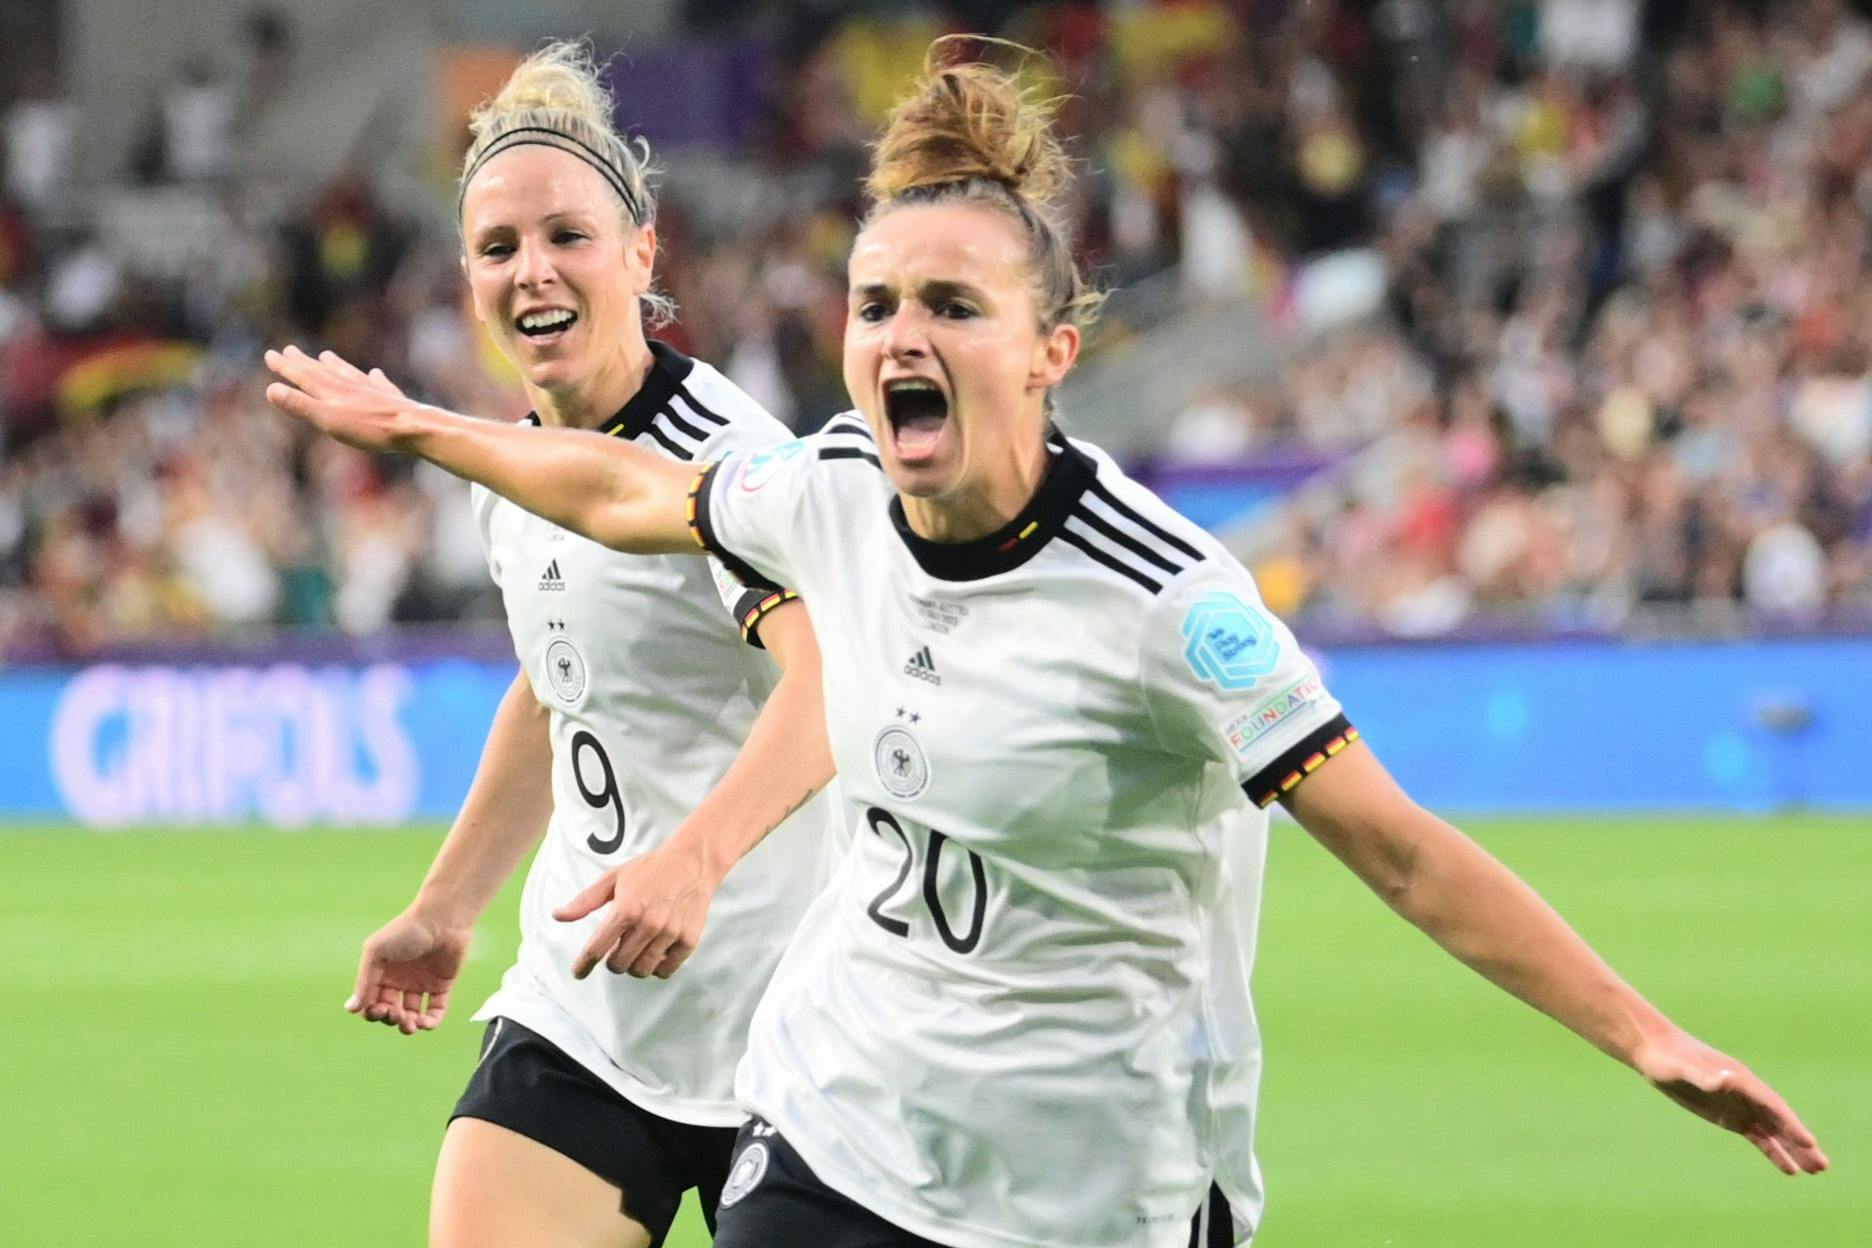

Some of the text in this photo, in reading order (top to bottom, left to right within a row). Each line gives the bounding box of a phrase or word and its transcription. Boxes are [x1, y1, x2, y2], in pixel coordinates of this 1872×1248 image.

[538, 579, 566, 592] adidas
[903, 664, 941, 686] adidas
[572, 731, 625, 855] 9
[866, 806, 988, 955] 20
